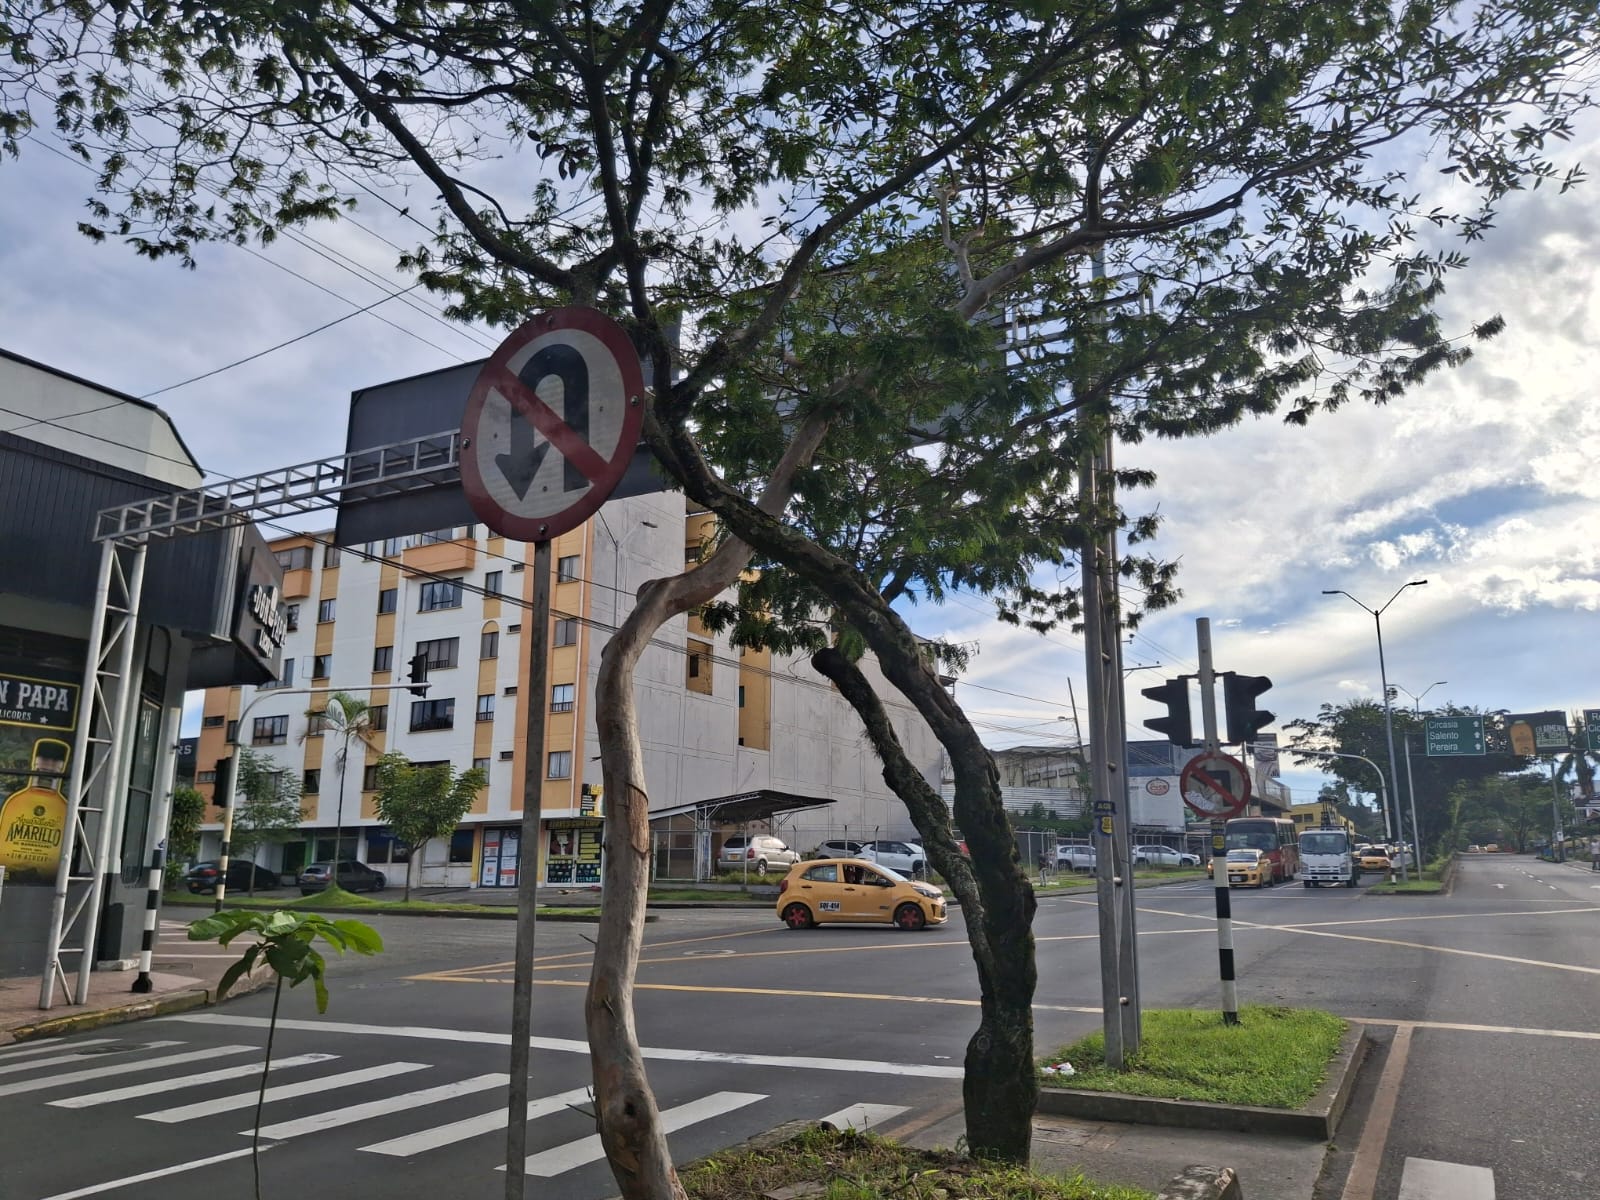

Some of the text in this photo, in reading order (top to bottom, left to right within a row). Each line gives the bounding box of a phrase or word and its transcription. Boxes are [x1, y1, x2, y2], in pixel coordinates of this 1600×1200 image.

[16, 682, 69, 712] PAPA
[1428, 720, 1458, 729] Circasia
[1429, 731, 1459, 740] Salento
[1430, 742, 1458, 751] Pereira
[5, 823, 62, 847] AMARILLO
